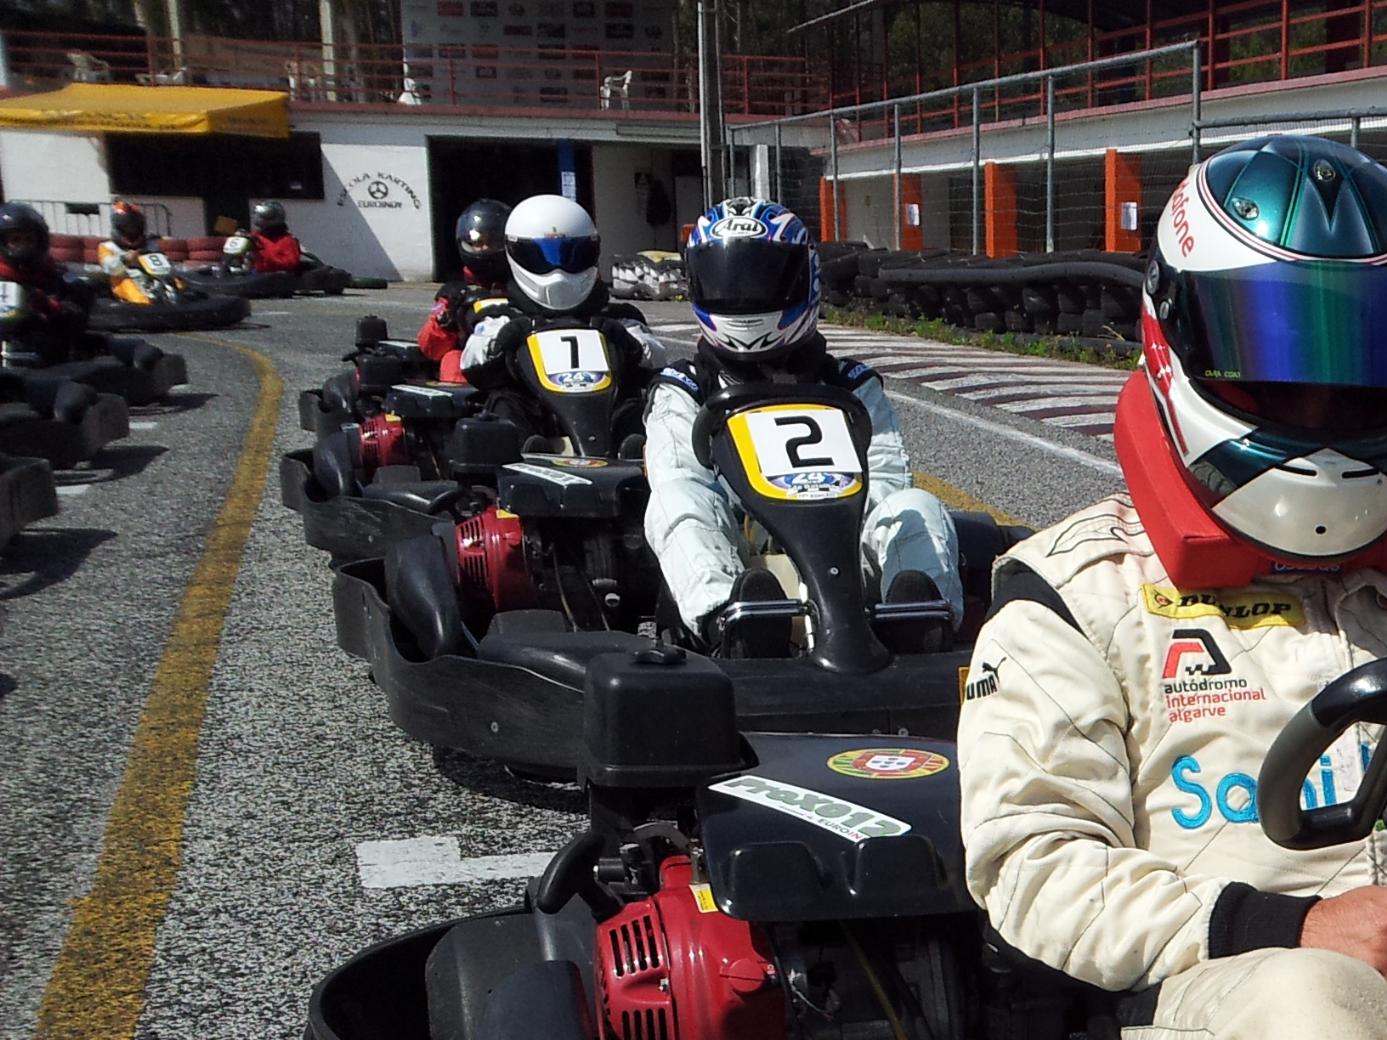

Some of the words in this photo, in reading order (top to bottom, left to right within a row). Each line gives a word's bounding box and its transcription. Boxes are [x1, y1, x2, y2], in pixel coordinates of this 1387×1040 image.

[715, 219, 758, 234] Arai
[149, 255, 163, 266] 8
[561, 336, 579, 369] 1
[774, 415, 835, 468] 2
[966, 674, 998, 701] UMA
[1163, 678, 1248, 695] autódromo
[1166, 688, 1267, 709] internacional
[1168, 706, 1227, 724] algarve
